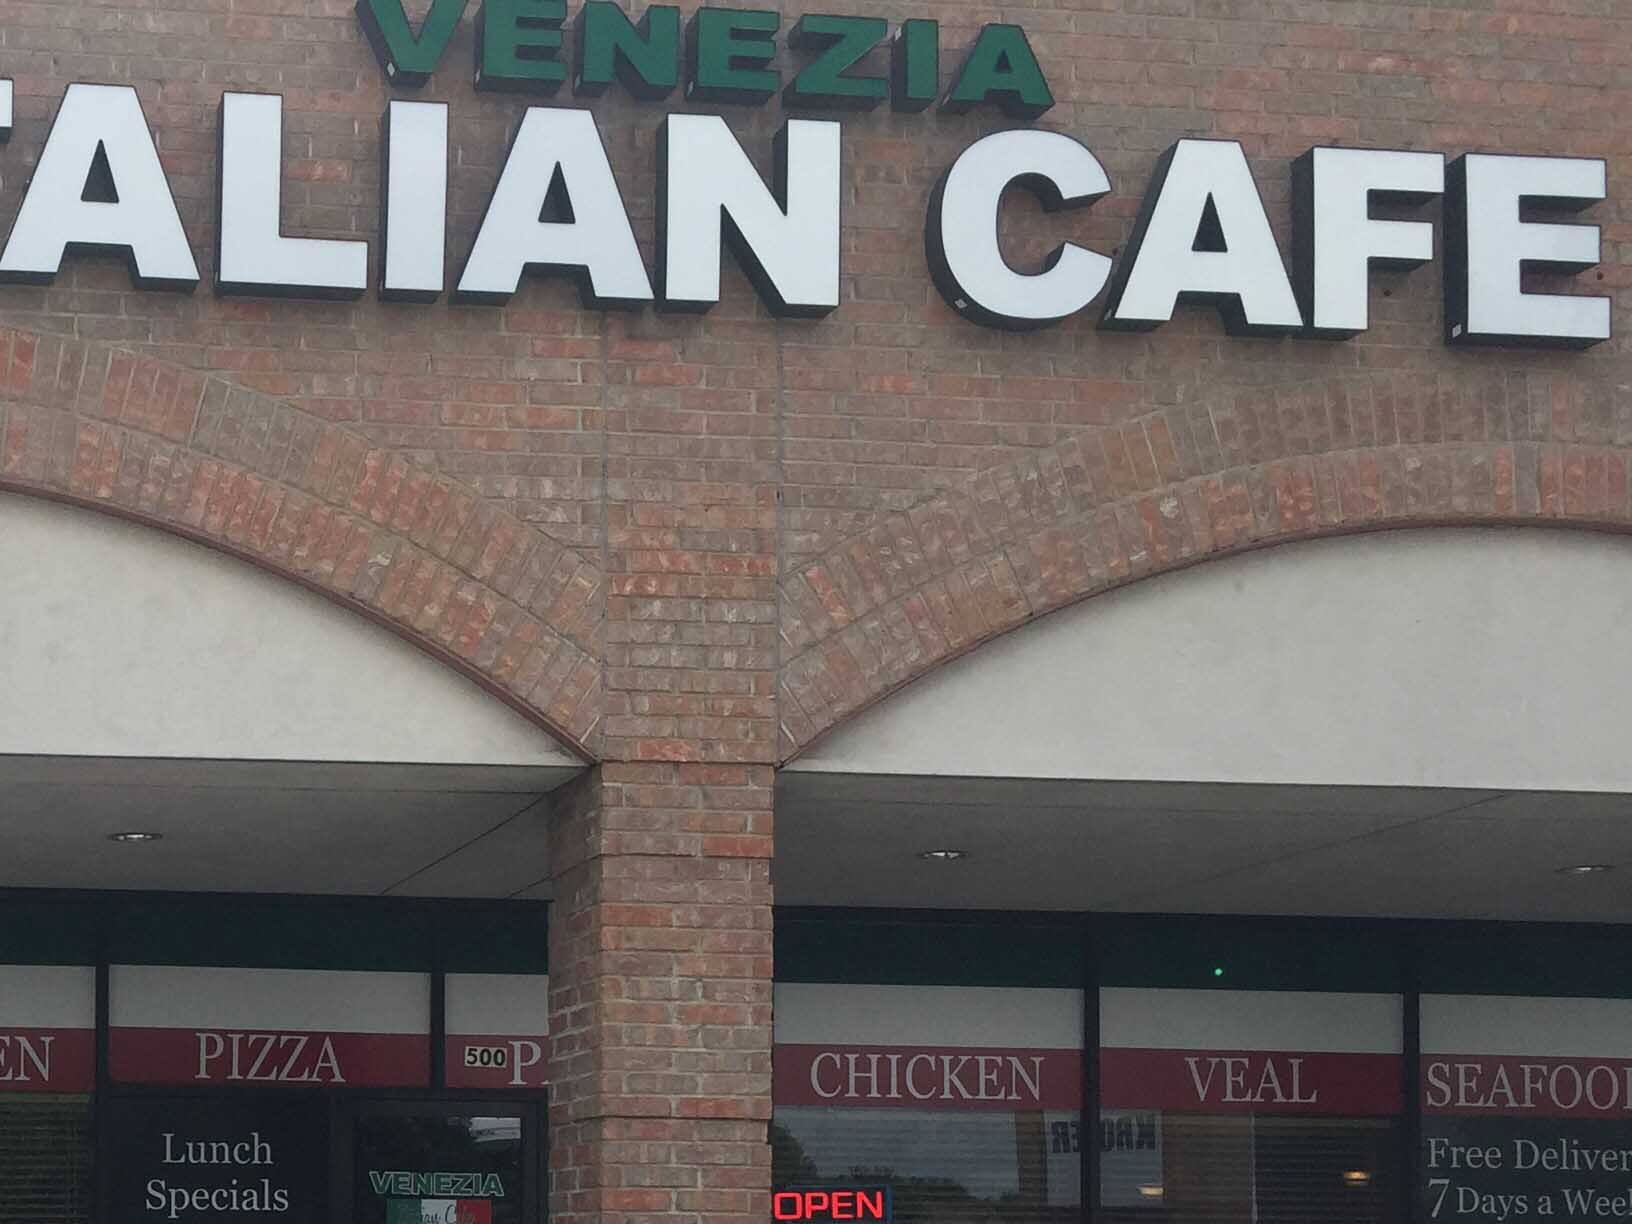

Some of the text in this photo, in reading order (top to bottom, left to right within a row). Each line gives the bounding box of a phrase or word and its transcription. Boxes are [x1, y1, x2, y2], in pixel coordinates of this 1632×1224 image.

[360, 0, 1054, 114] VENEZIA
[935, 128, 1612, 343] CAFE
[195, 1032, 346, 1083] PIZZA
[466, 1047, 506, 1067] 500
[810, 1052, 1045, 1102] CHICKEN
[1185, 1056, 1318, 1104] VEAL
[1426, 1062, 1632, 1110] SEAFOO
[161, 1132, 274, 1164] Lunch
[1427, 1137, 1632, 1172] Free Deliver
[145, 1178, 289, 1219] Specials
[369, 1171, 504, 1197] VENEZIA
[773, 1189, 885, 1221] OPEN
[1428, 1178, 1632, 1221] 7 Days a Wee
